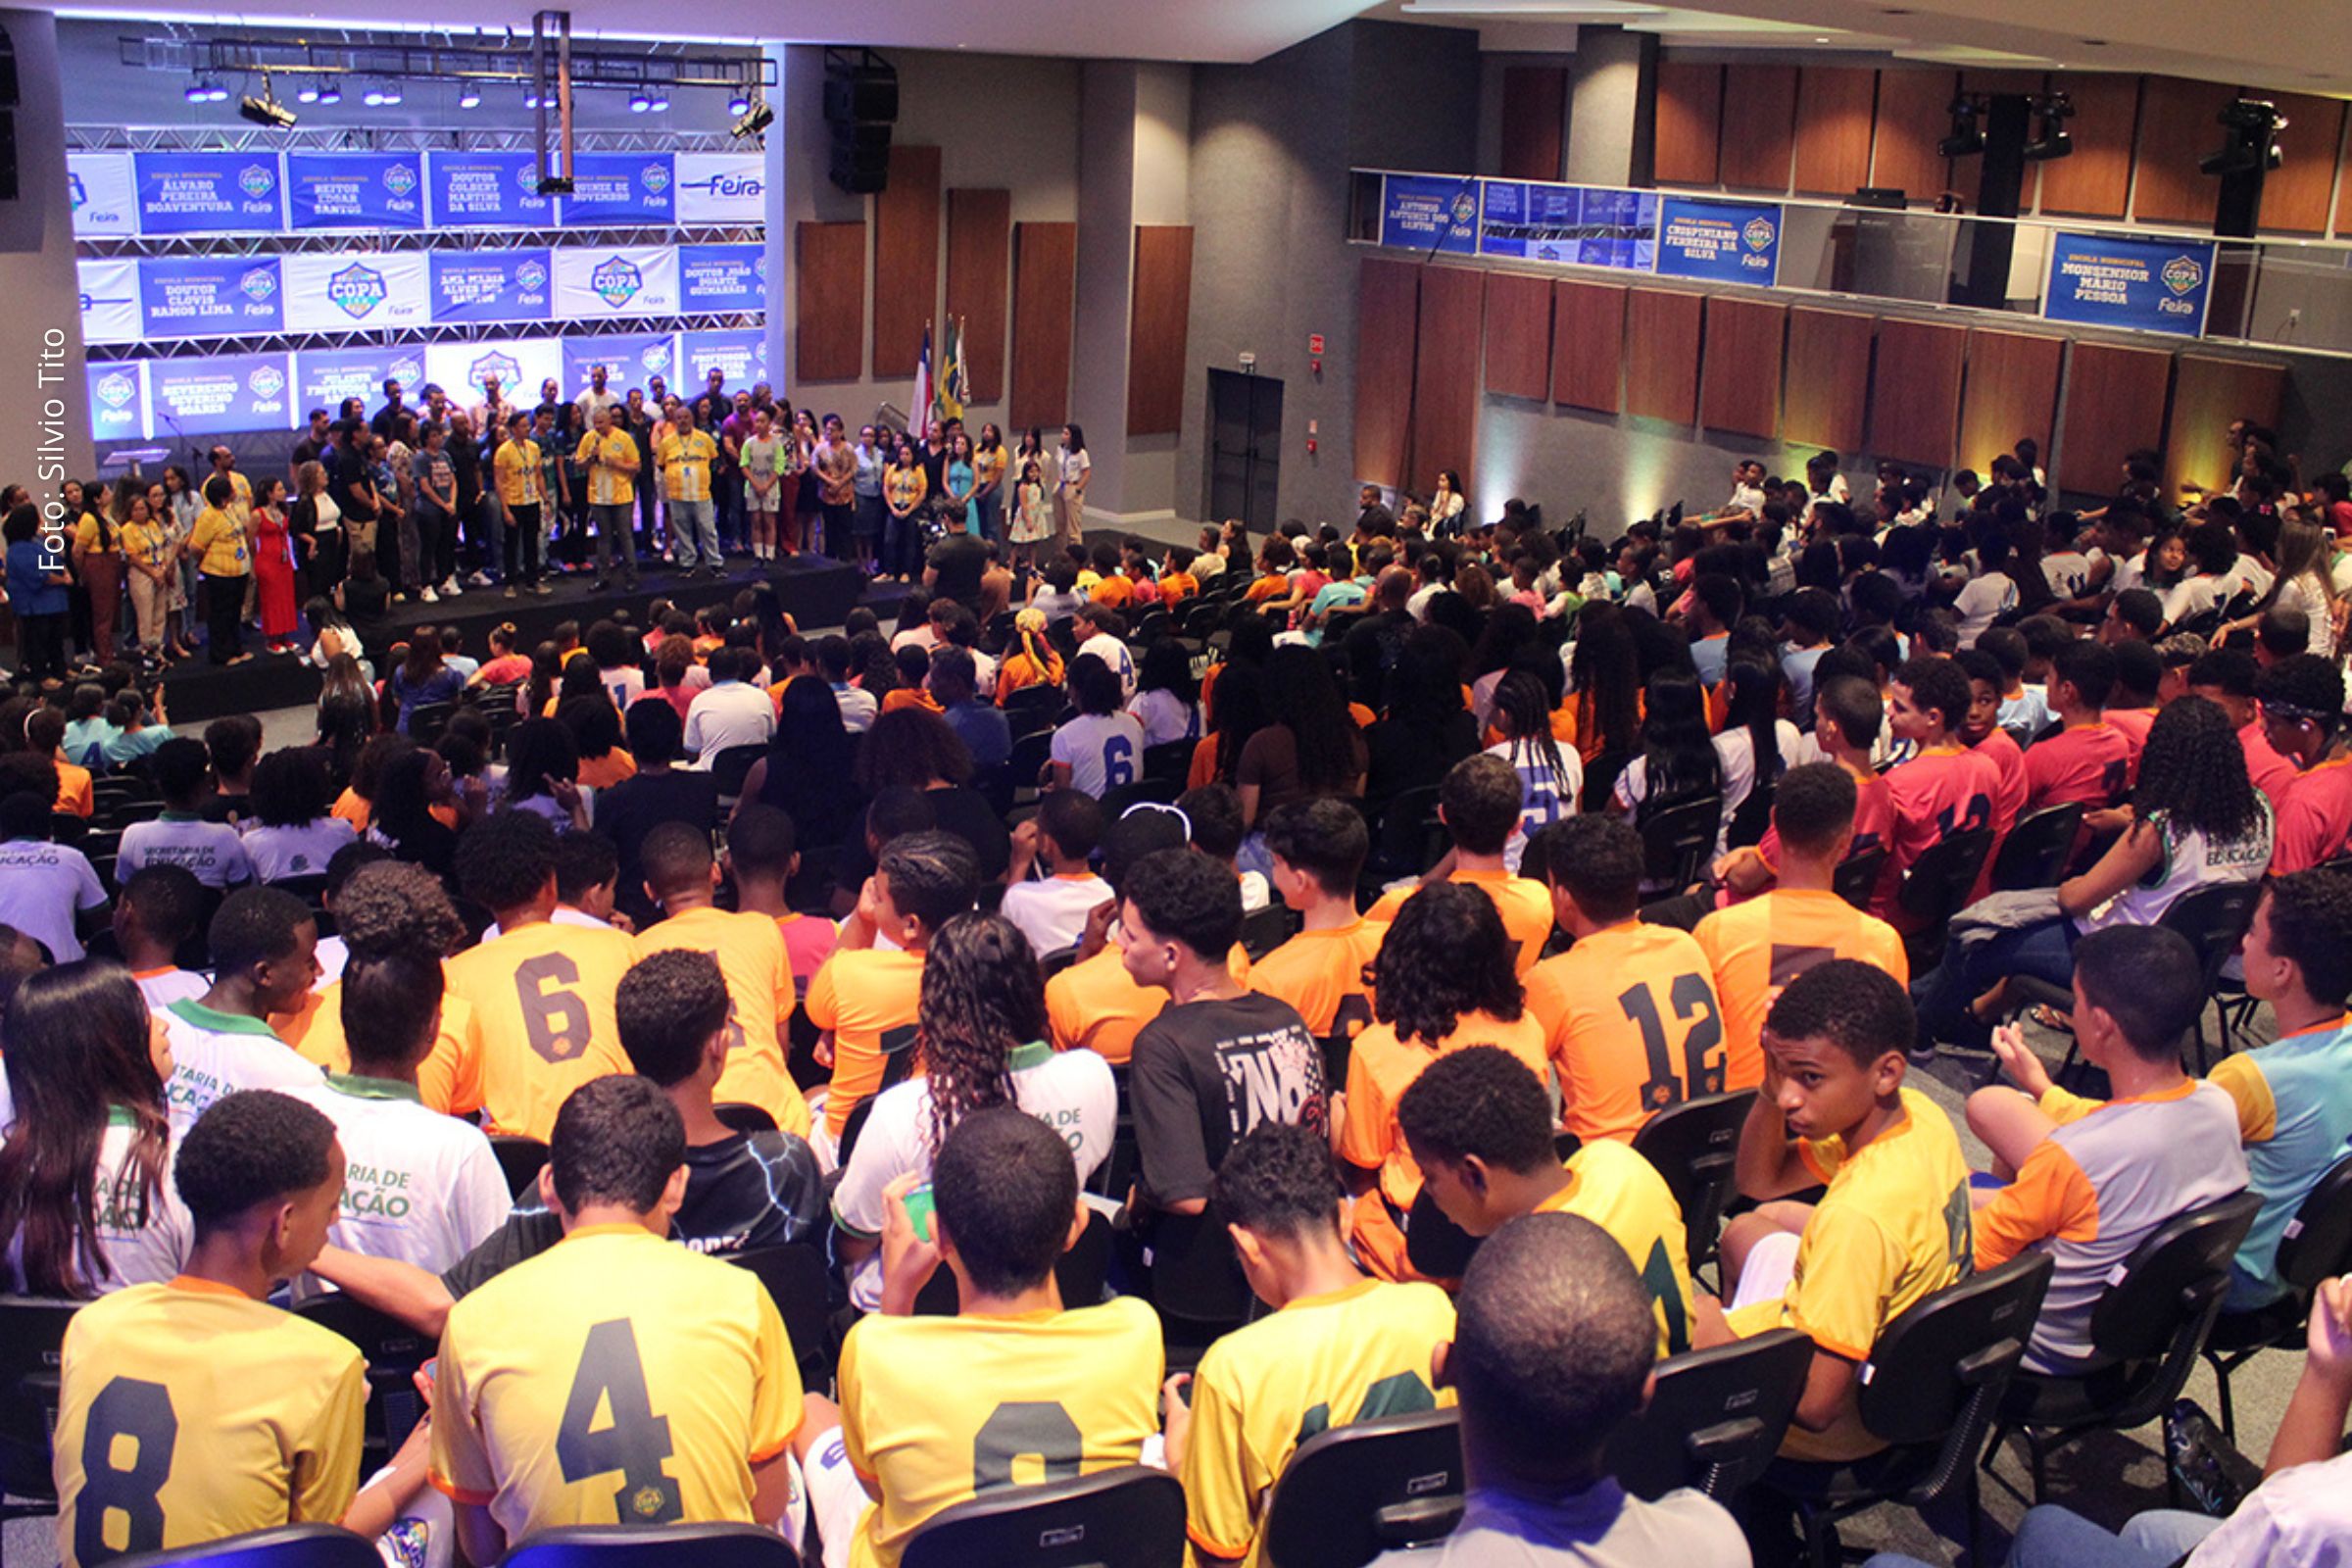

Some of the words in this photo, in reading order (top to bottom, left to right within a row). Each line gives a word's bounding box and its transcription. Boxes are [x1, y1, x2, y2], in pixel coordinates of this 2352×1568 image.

[710, 174, 760, 196] Feira
[161, 192, 218, 202] PEREIRA
[146, 202, 234, 213] BOAVENTURA
[243, 202, 273, 214] Feira
[449, 202, 465, 213] DA
[468, 202, 502, 212] SILVA
[89, 212, 120, 222] Feira
[1722, 241, 1738, 251] DA
[1684, 247, 1717, 261] SILVA
[1741, 253, 1769, 268] Feira
[2061, 263, 2150, 282] MONSENHOR
[2166, 270, 2198, 282] COPA
[594, 274, 640, 288] COPA
[165, 284, 216, 296] DOUTOR
[331, 282, 384, 298] COPA
[2075, 288, 2128, 305] PESSOA
[151, 306, 196, 318] RAMOS
[200, 304, 234, 316] LIMA
[244, 304, 274, 316] Feira
[2158, 297, 2194, 315] Feira
[177, 404, 225, 416] SOARES
[253, 401, 282, 413] Feira
[1103, 734, 1134, 792] 6
[202, 846, 216, 855] DE
[514, 951, 593, 1063] 6
[1618, 972, 1728, 1113] 12
[1058, 1107, 1082, 1125] DE
[348, 1163, 378, 1185] RIA
[382, 1170, 412, 1189] DE
[340, 1186, 411, 1218] AÇÃO
[556, 1317, 684, 1525] 4
[74, 1375, 179, 1568] 8
